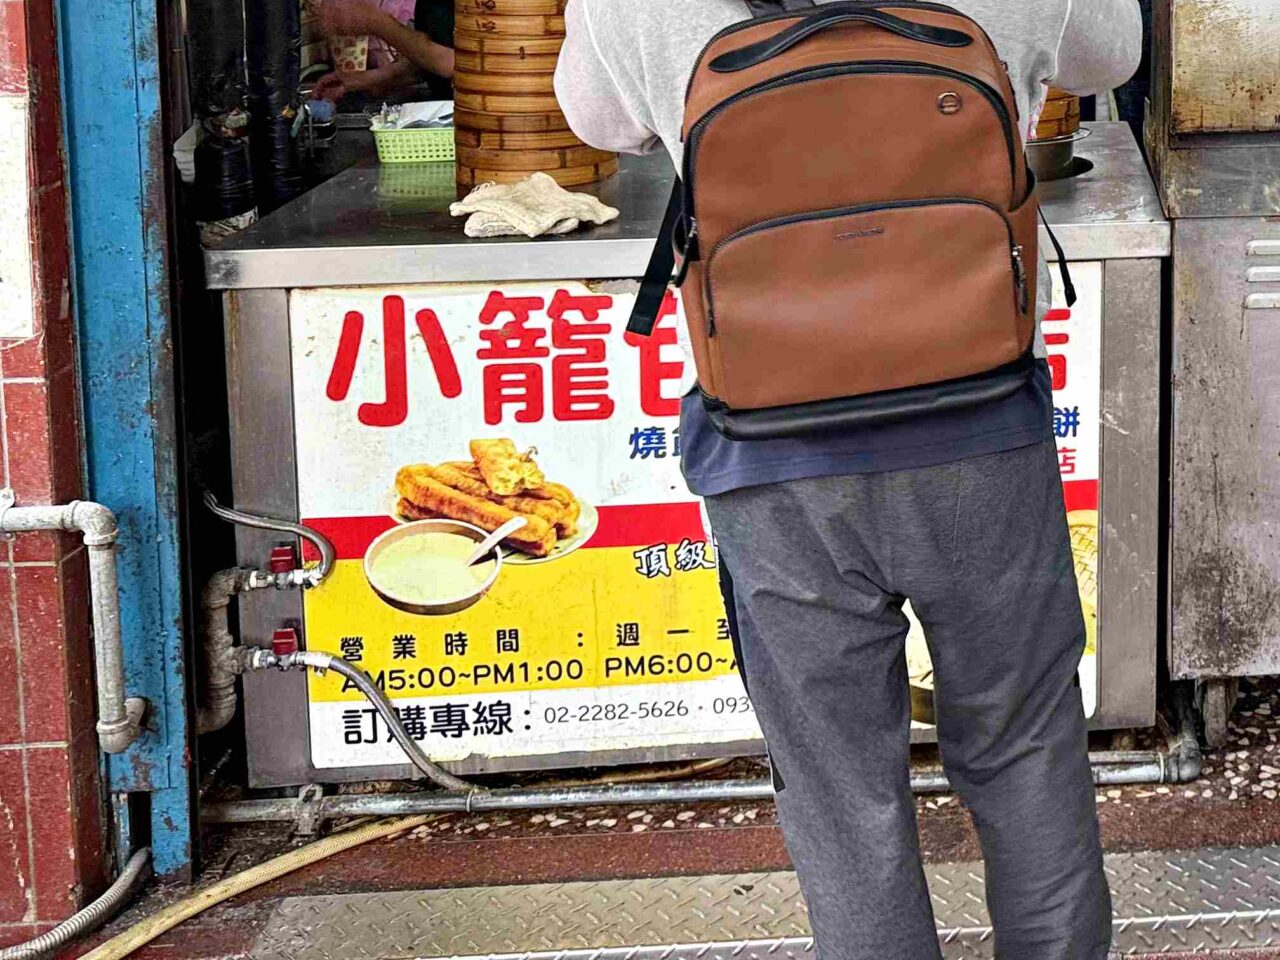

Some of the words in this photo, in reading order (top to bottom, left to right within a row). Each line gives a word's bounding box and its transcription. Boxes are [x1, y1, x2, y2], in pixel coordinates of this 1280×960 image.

[629, 426, 681, 459] 燒
[634, 538, 719, 578] 頂級
[544, 699, 689, 724] 02-2282-5626
[713, 696, 752, 715] 093
